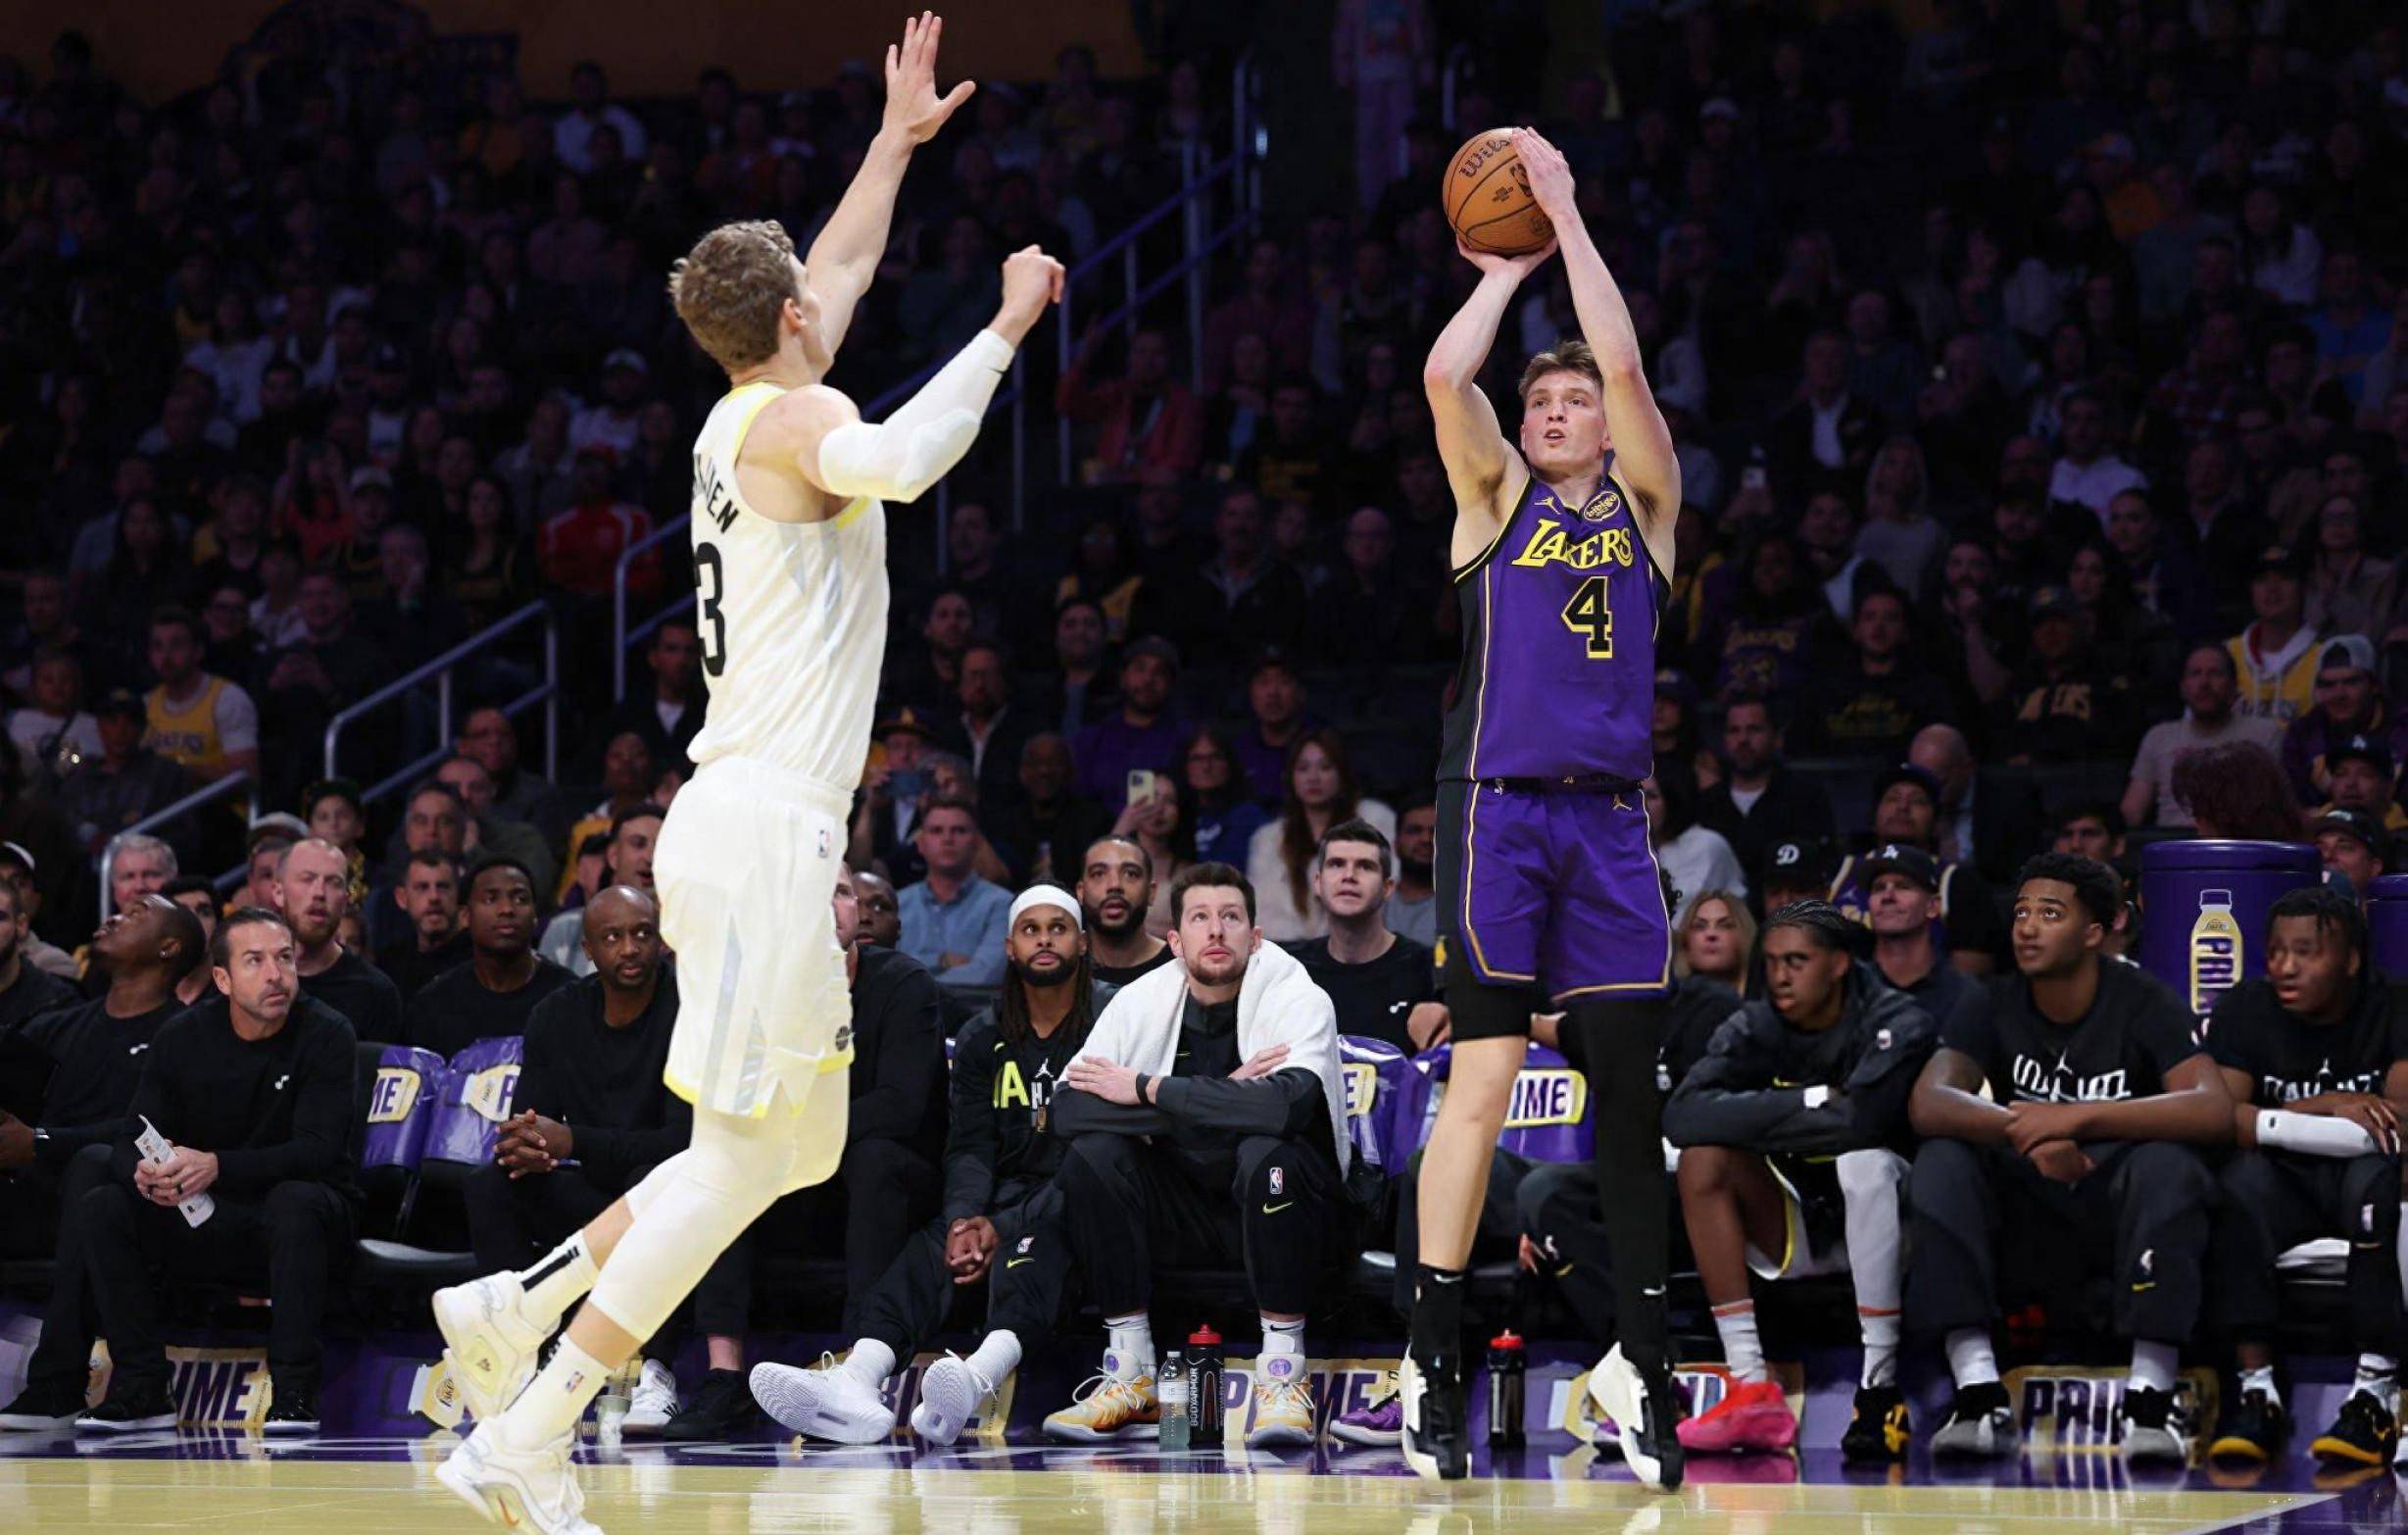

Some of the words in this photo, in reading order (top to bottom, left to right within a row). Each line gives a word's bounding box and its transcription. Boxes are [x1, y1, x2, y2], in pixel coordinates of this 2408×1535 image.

[1511, 518, 1635, 569] LAKERS
[1561, 575, 1613, 659] 4
[1775, 843, 1801, 867] D
[1512, 1077, 1569, 1119] IME
[172, 1362, 261, 1421] IME
[1189, 1366, 1200, 1427] BODYARMOR
